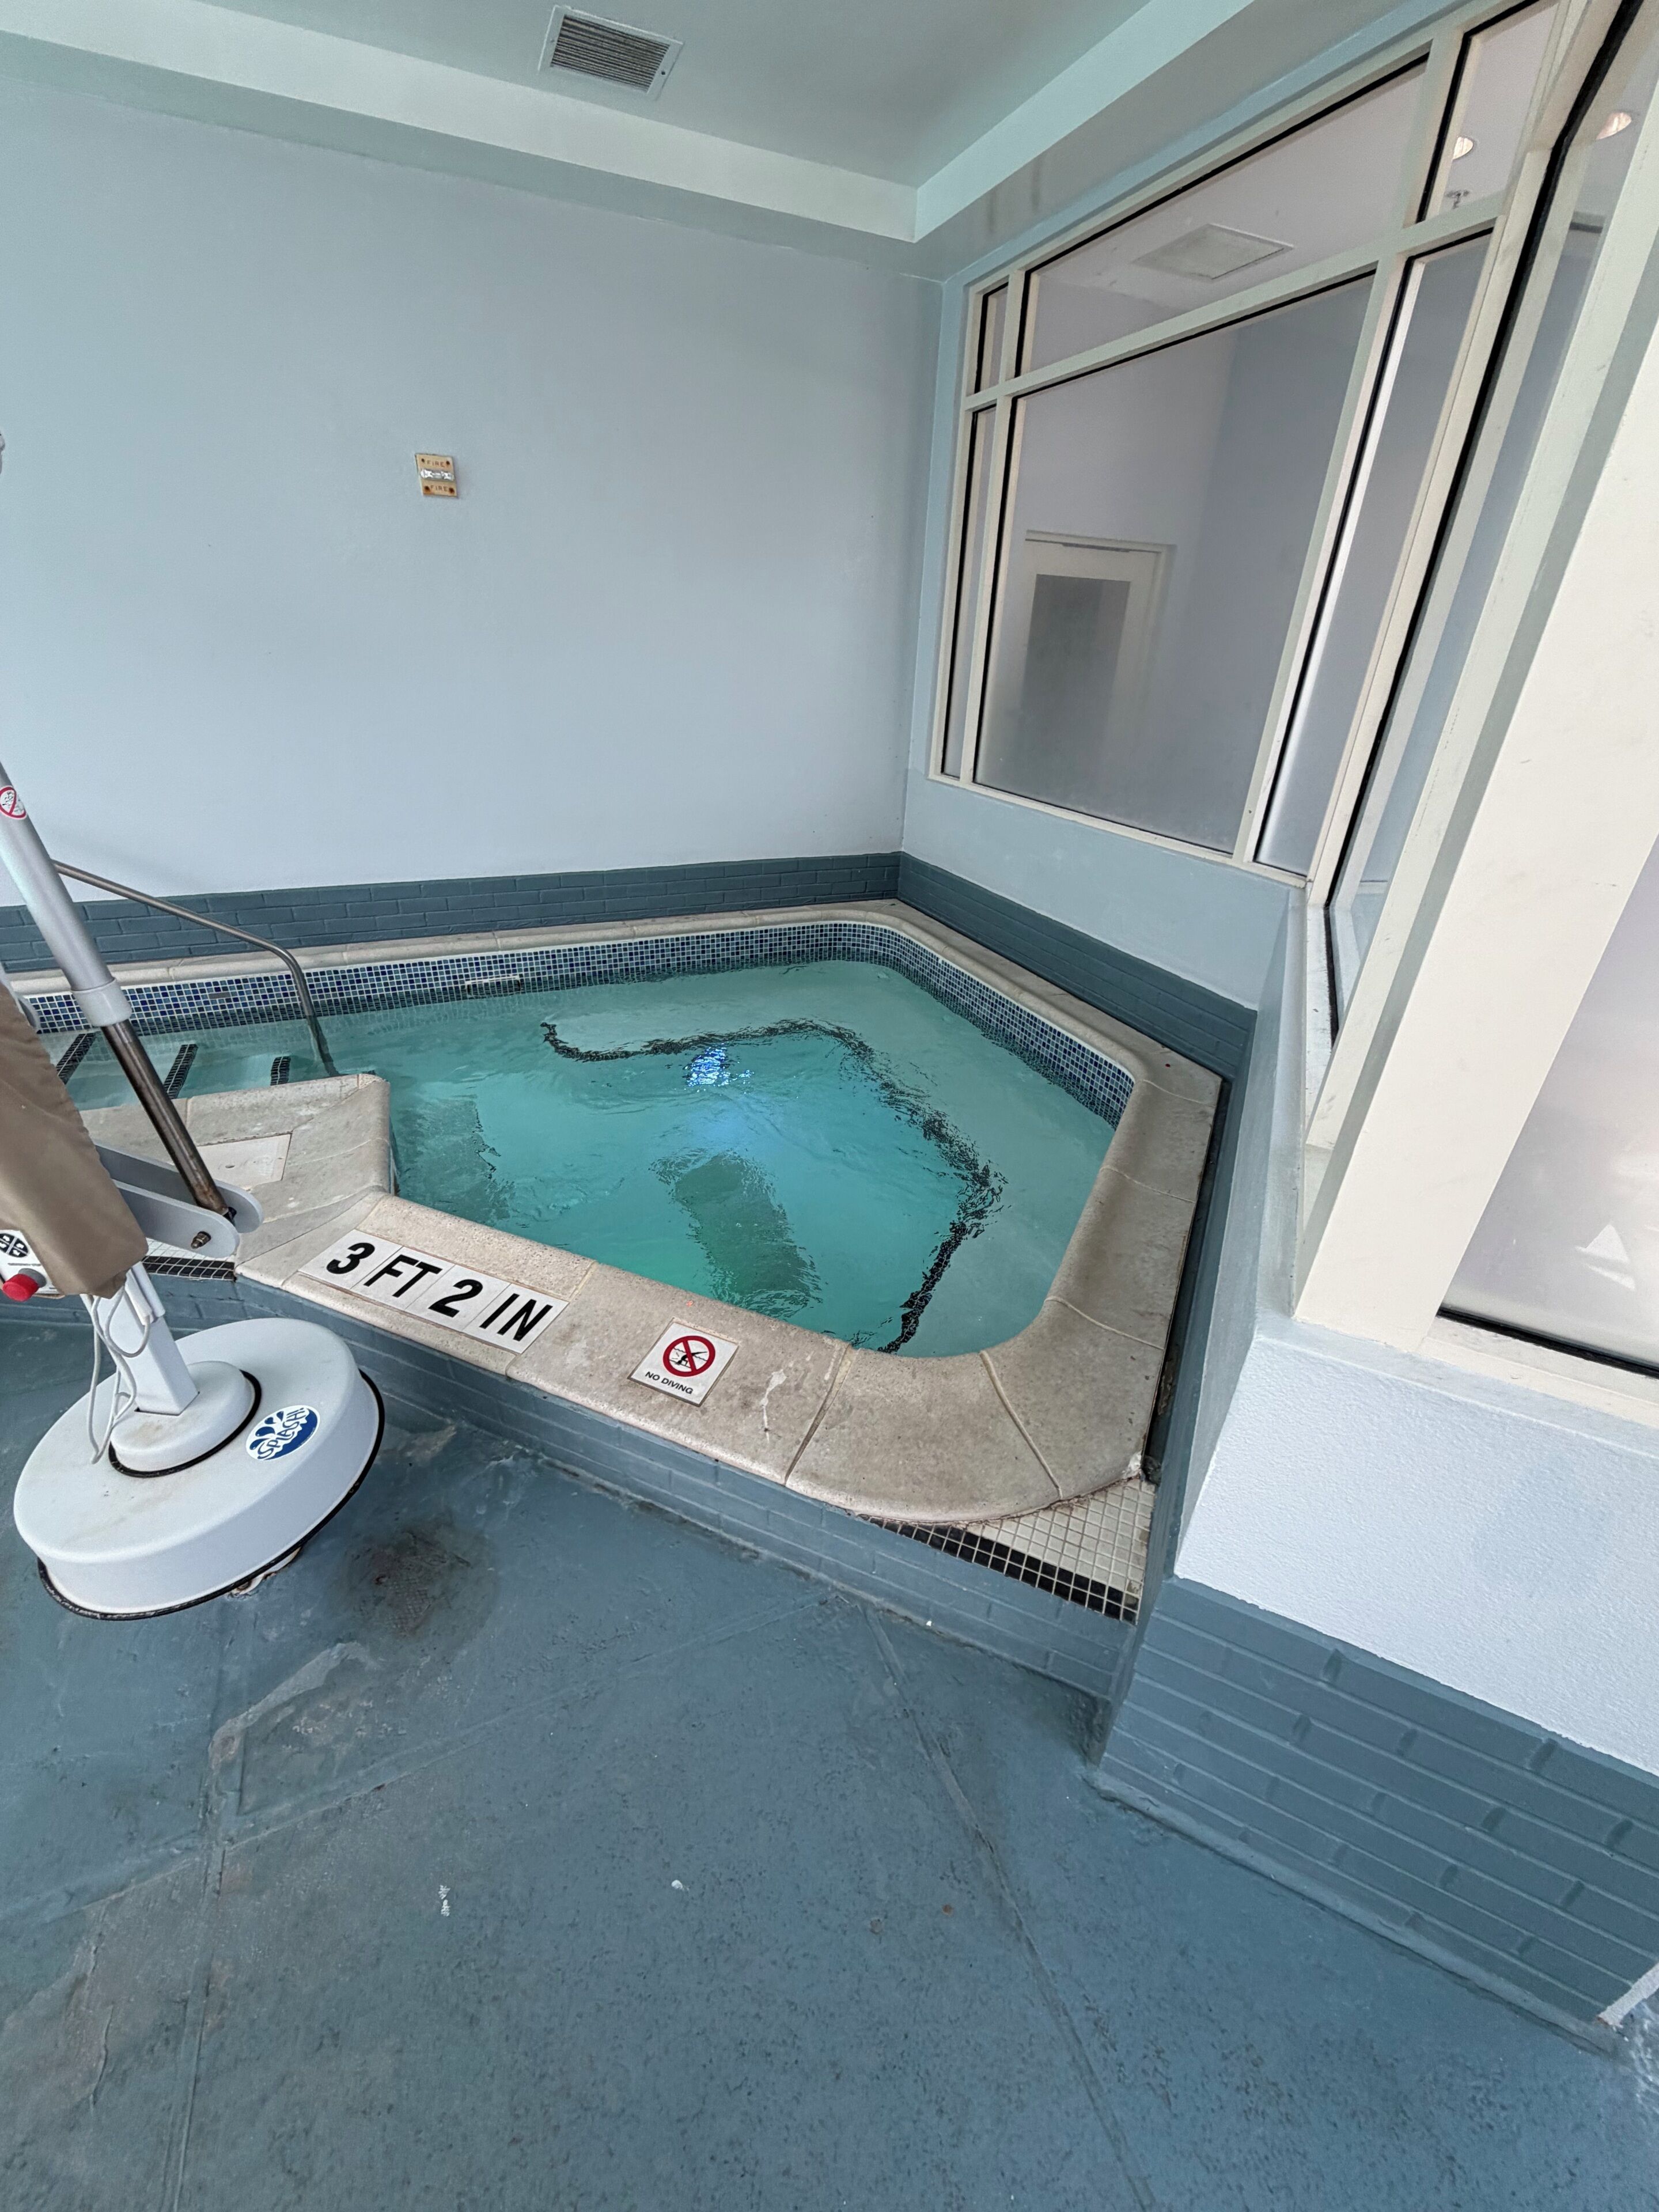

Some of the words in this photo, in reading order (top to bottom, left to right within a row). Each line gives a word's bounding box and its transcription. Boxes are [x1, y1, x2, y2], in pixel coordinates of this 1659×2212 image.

[326, 1242, 376, 1275] 3
[363, 1254, 443, 1298] FT
[428, 1279, 484, 1318] 2
[479, 1293, 554, 1342] IN
[645, 1371, 661, 1381] NO
[661, 1377, 694, 1395] DIVING
